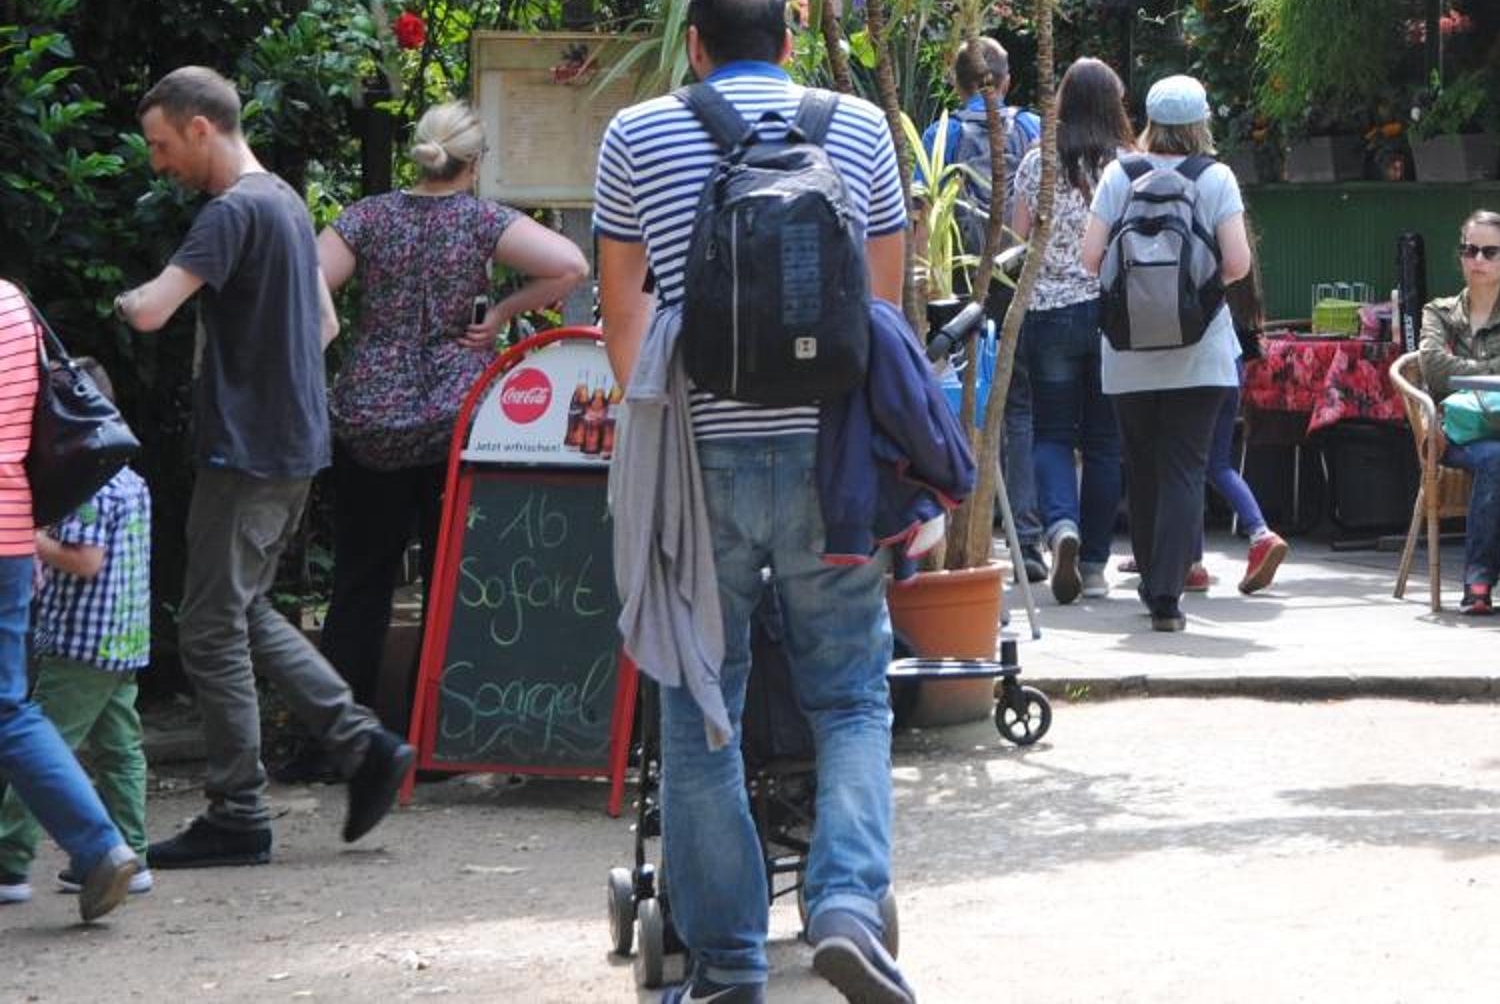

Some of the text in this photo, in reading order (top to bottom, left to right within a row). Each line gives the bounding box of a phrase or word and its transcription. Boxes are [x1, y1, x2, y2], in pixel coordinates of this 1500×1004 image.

[502, 387, 549, 405] Coca-Cola
[475, 441, 501, 453] Jetzt
[499, 495, 568, 549] Ab
[458, 554, 605, 646] Sofort
[438, 660, 617, 752] Spargel
